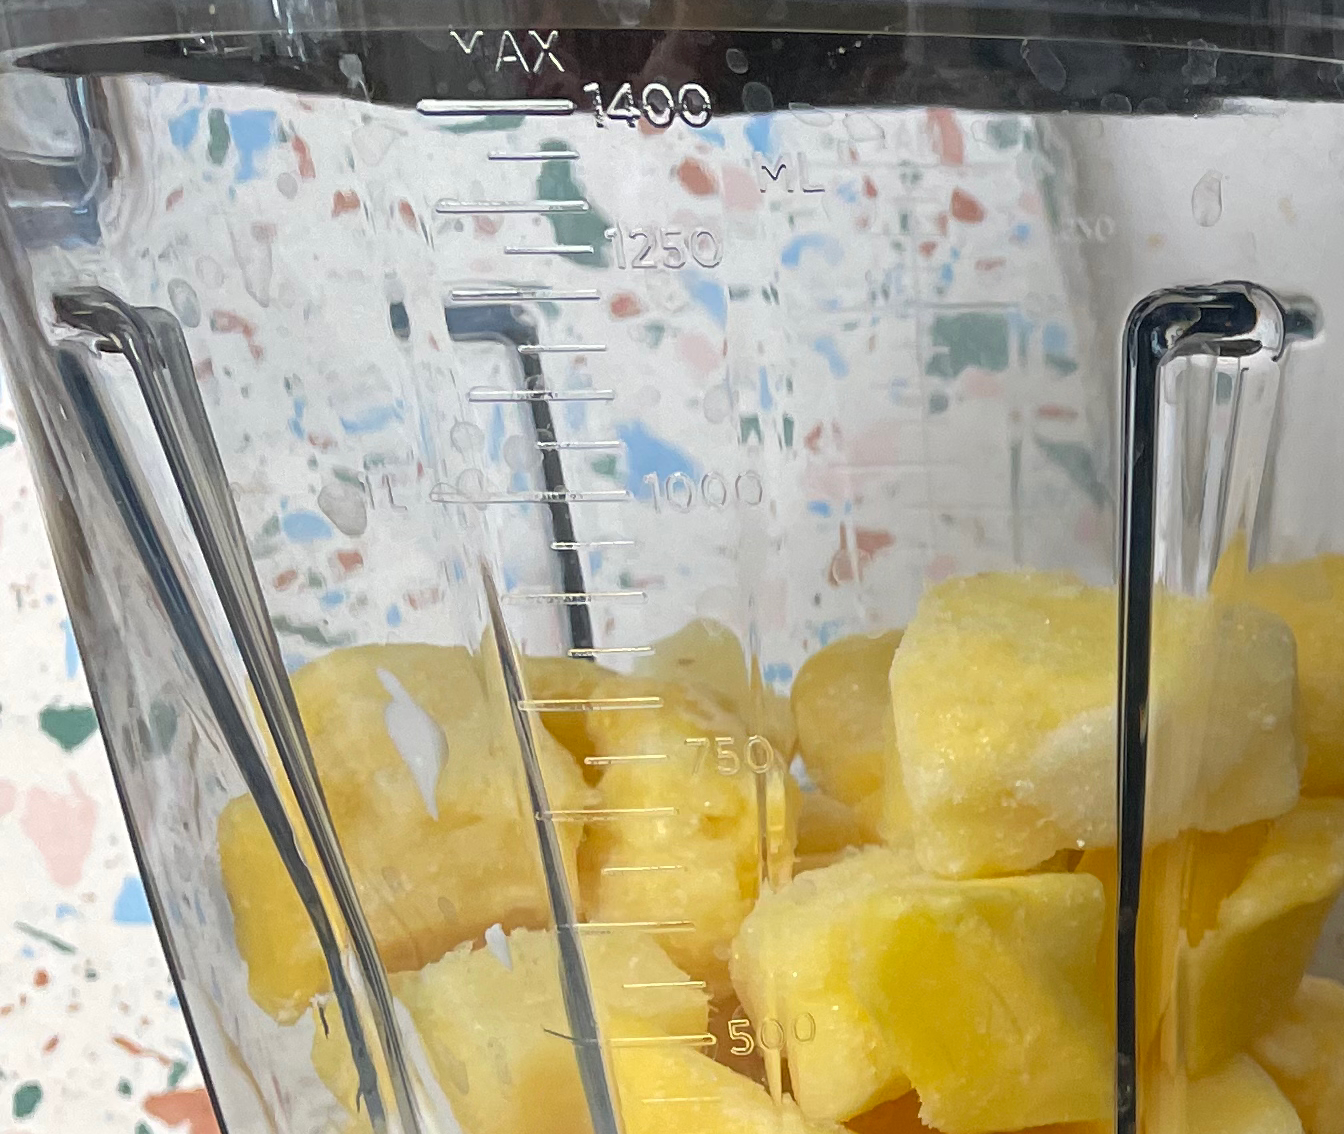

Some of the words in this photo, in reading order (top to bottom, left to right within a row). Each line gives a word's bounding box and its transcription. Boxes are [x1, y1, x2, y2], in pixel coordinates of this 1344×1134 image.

[583, 82, 713, 129] 1400
[604, 222, 724, 270] 1250
[642, 469, 765, 515] 1000
[684, 734, 775, 775] 750
[728, 1011, 817, 1058] 500
